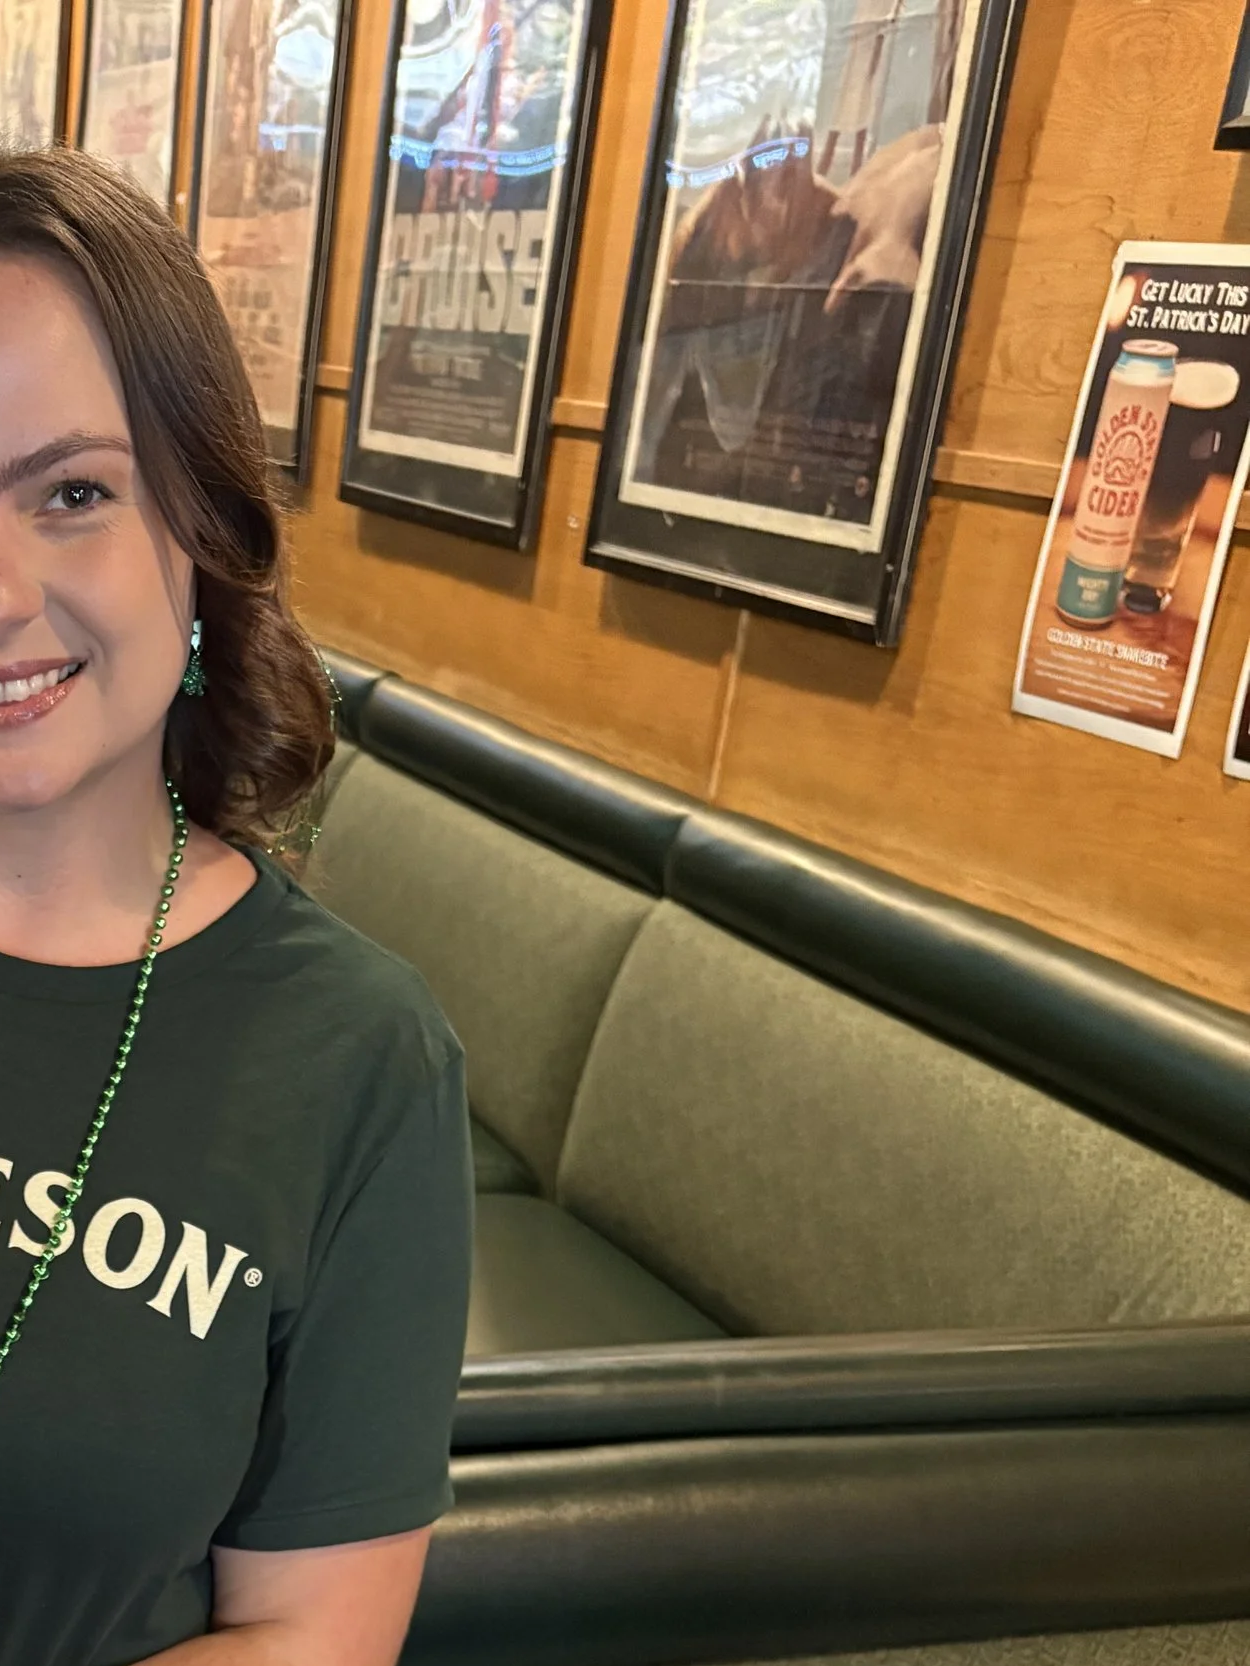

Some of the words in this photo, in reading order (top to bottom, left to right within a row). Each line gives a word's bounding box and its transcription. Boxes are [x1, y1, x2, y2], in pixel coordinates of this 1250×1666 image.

[1141, 279, 1170, 302] GET
[1169, 280, 1214, 305] LUCKY
[1216, 282, 1249, 307] THIS
[1126, 305, 1149, 328] ST.
[1150, 306, 1219, 333] PATRICK'S
[1219, 310, 1250, 335] DAY
[1088, 485, 1139, 517] CIDER
